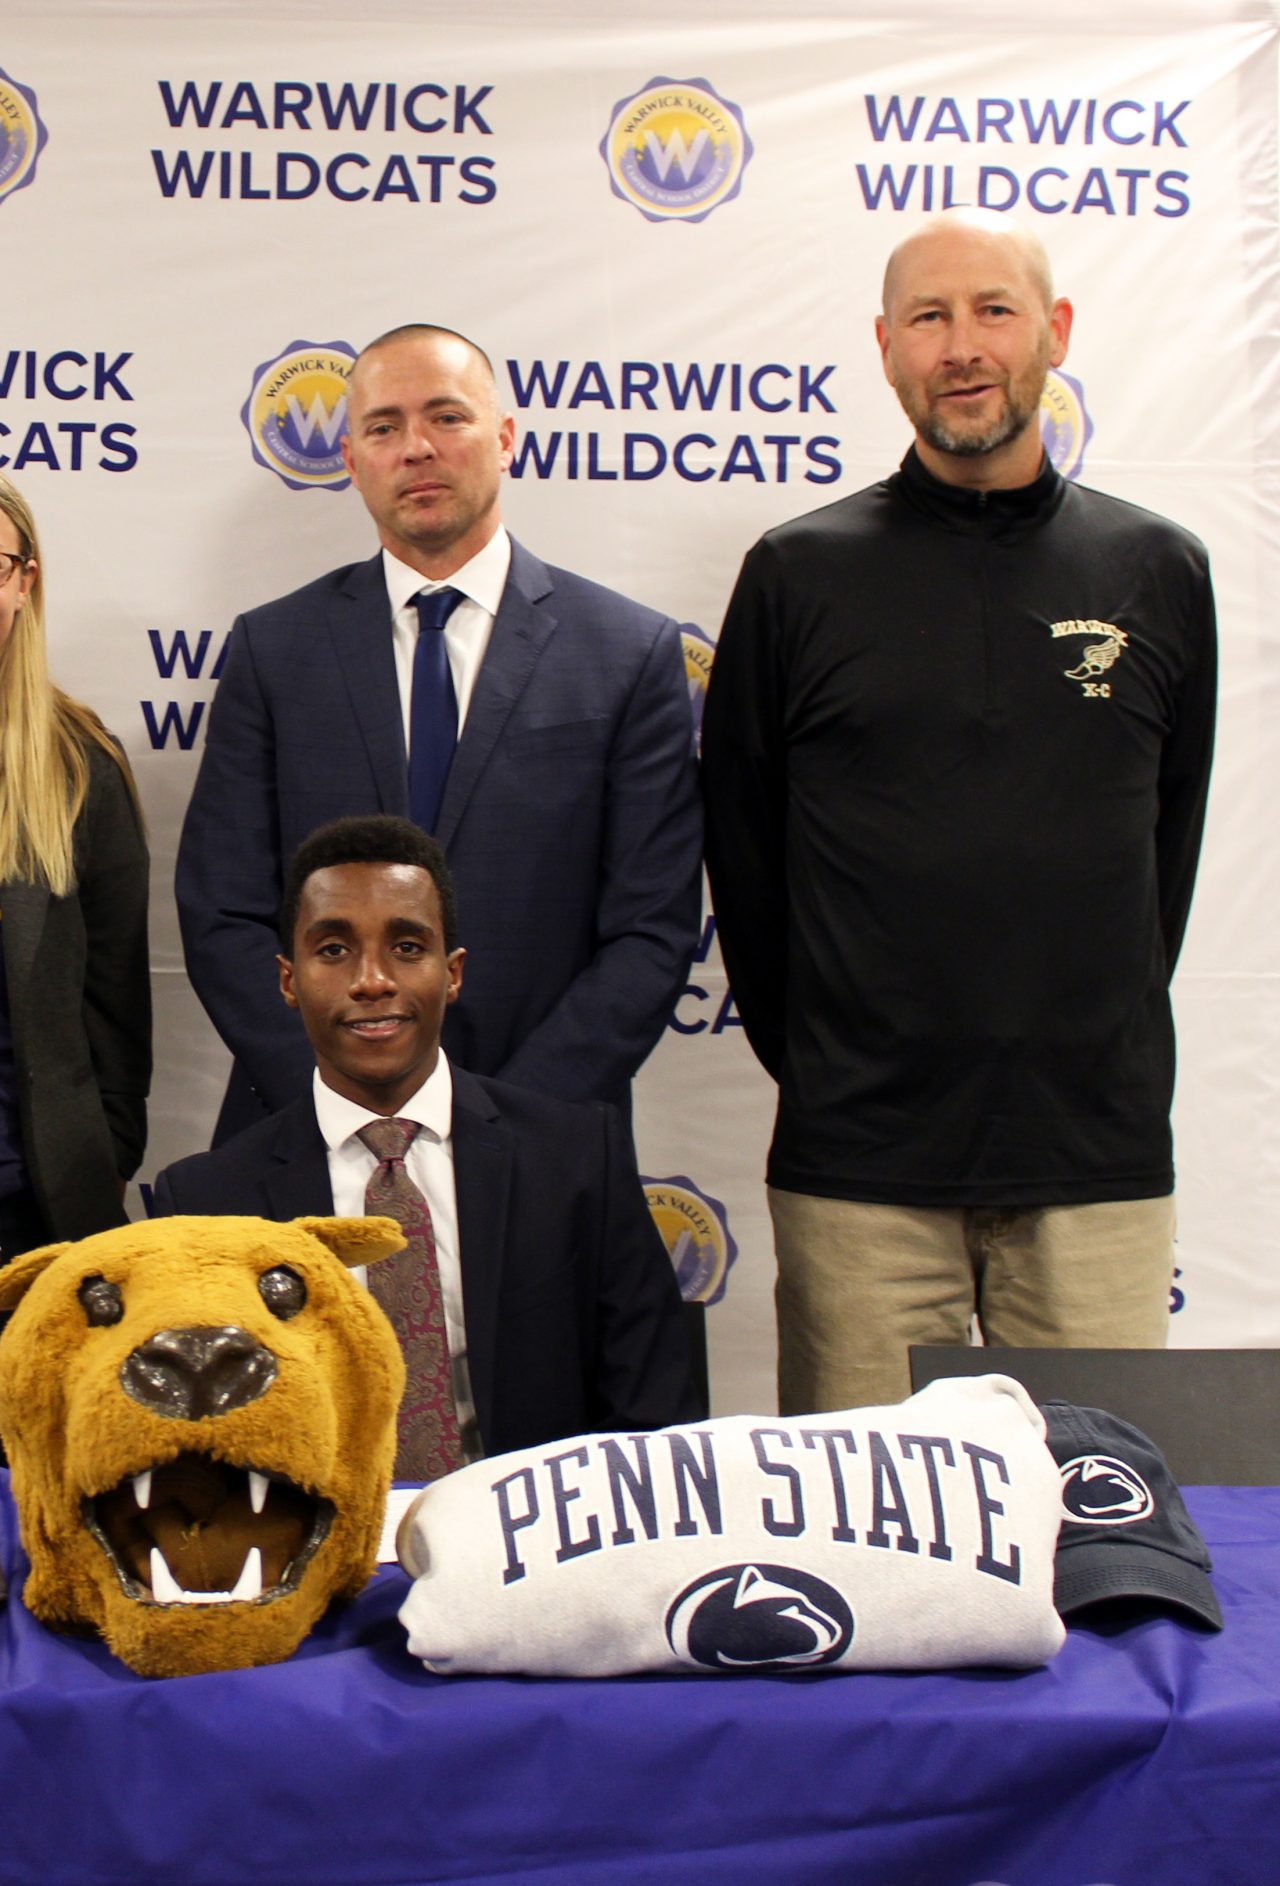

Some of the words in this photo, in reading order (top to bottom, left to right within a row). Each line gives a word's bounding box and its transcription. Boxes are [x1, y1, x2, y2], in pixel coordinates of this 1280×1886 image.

[158, 81, 493, 134] WARWICK
[624, 96, 683, 133] WARWICK
[687, 98, 728, 134] VALLEY
[864, 95, 1190, 147] WARWICK
[151, 150, 496, 204] WILDCATS
[856, 164, 1190, 218] WILDCATS
[266, 359, 325, 398] WARWICK
[506, 360, 837, 413] WARWICK
[510, 431, 842, 484] WILDCATS
[1081, 683, 1111, 698] X-C
[670, 1196, 710, 1235] VALLEY
[489, 1431, 723, 1586] PENN
[749, 1427, 1021, 1586] STATE
